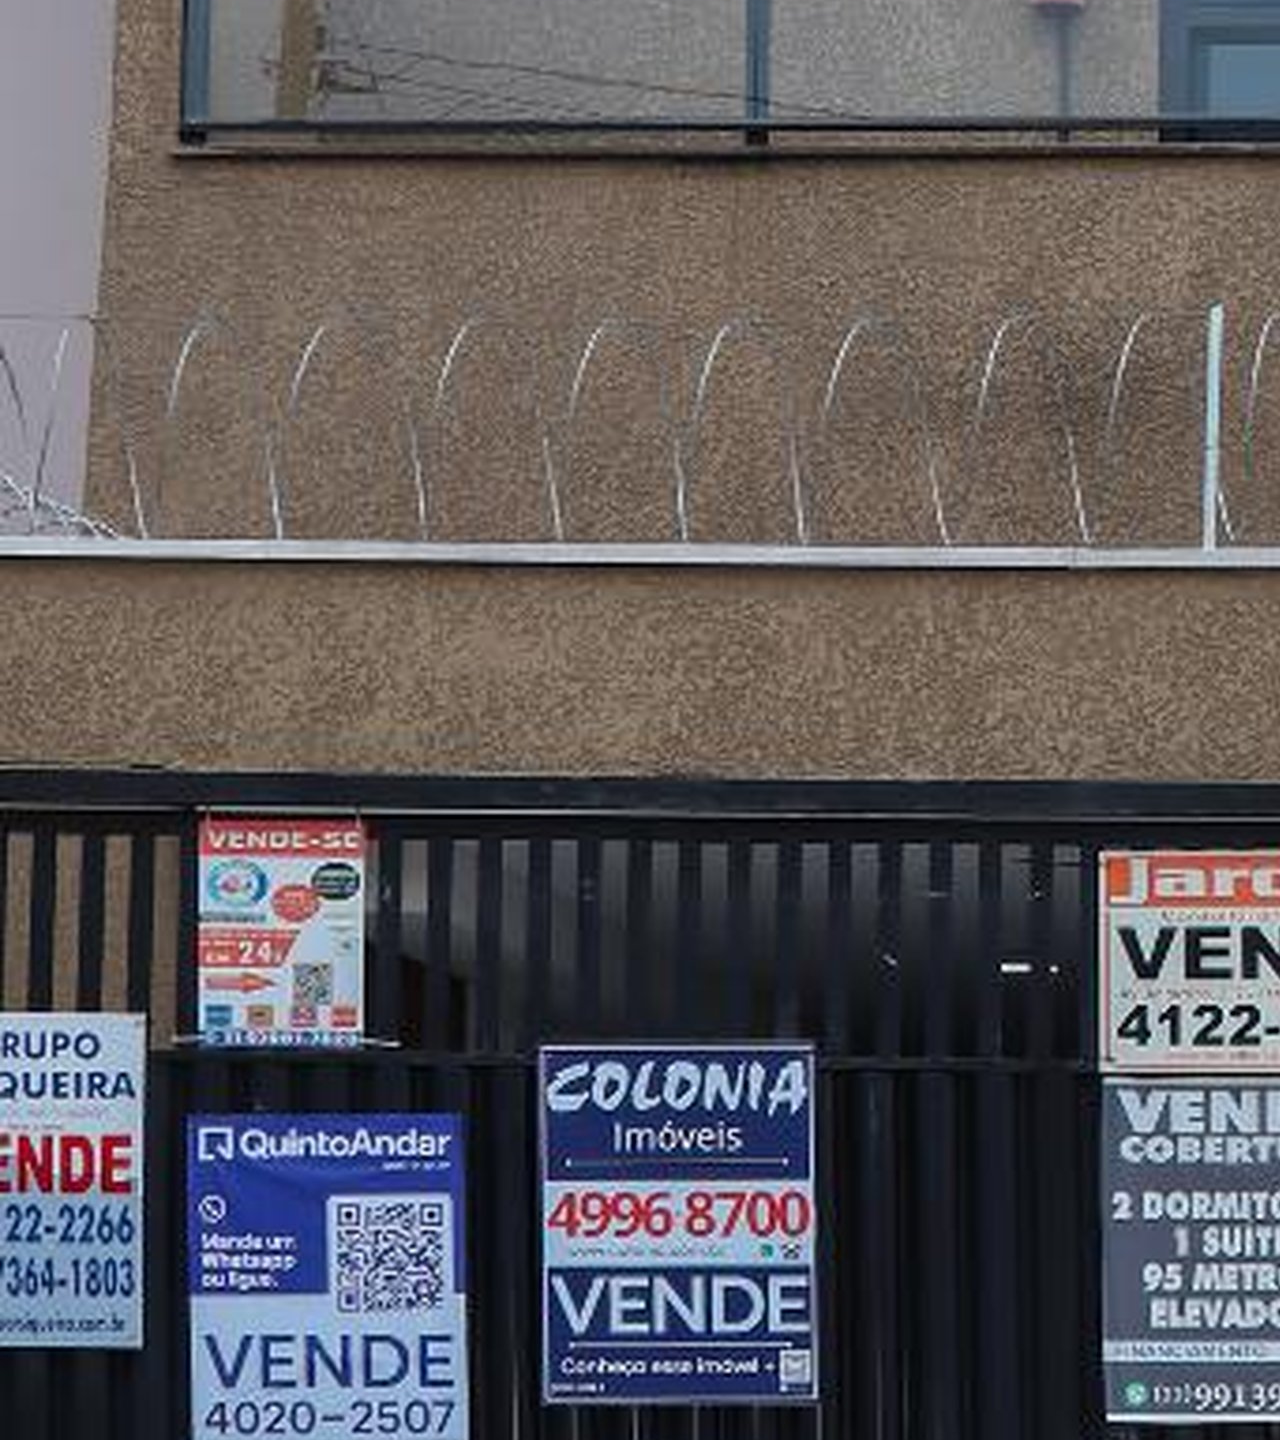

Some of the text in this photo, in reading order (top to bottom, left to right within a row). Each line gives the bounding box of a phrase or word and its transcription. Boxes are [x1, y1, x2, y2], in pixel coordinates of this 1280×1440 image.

[240, 1128, 452, 1161] QuintoAndar
[613, 1120, 743, 1152] Imóveis
[1111, 1191, 1134, 1220] 2
[1173, 1225, 1190, 1257] 1
[1142, 1262, 1183, 1291] 95
[550, 1275, 811, 1335] VENDE
[204, 1334, 455, 1389] VENDE
[205, 1401, 455, 1435] 4020-2507
